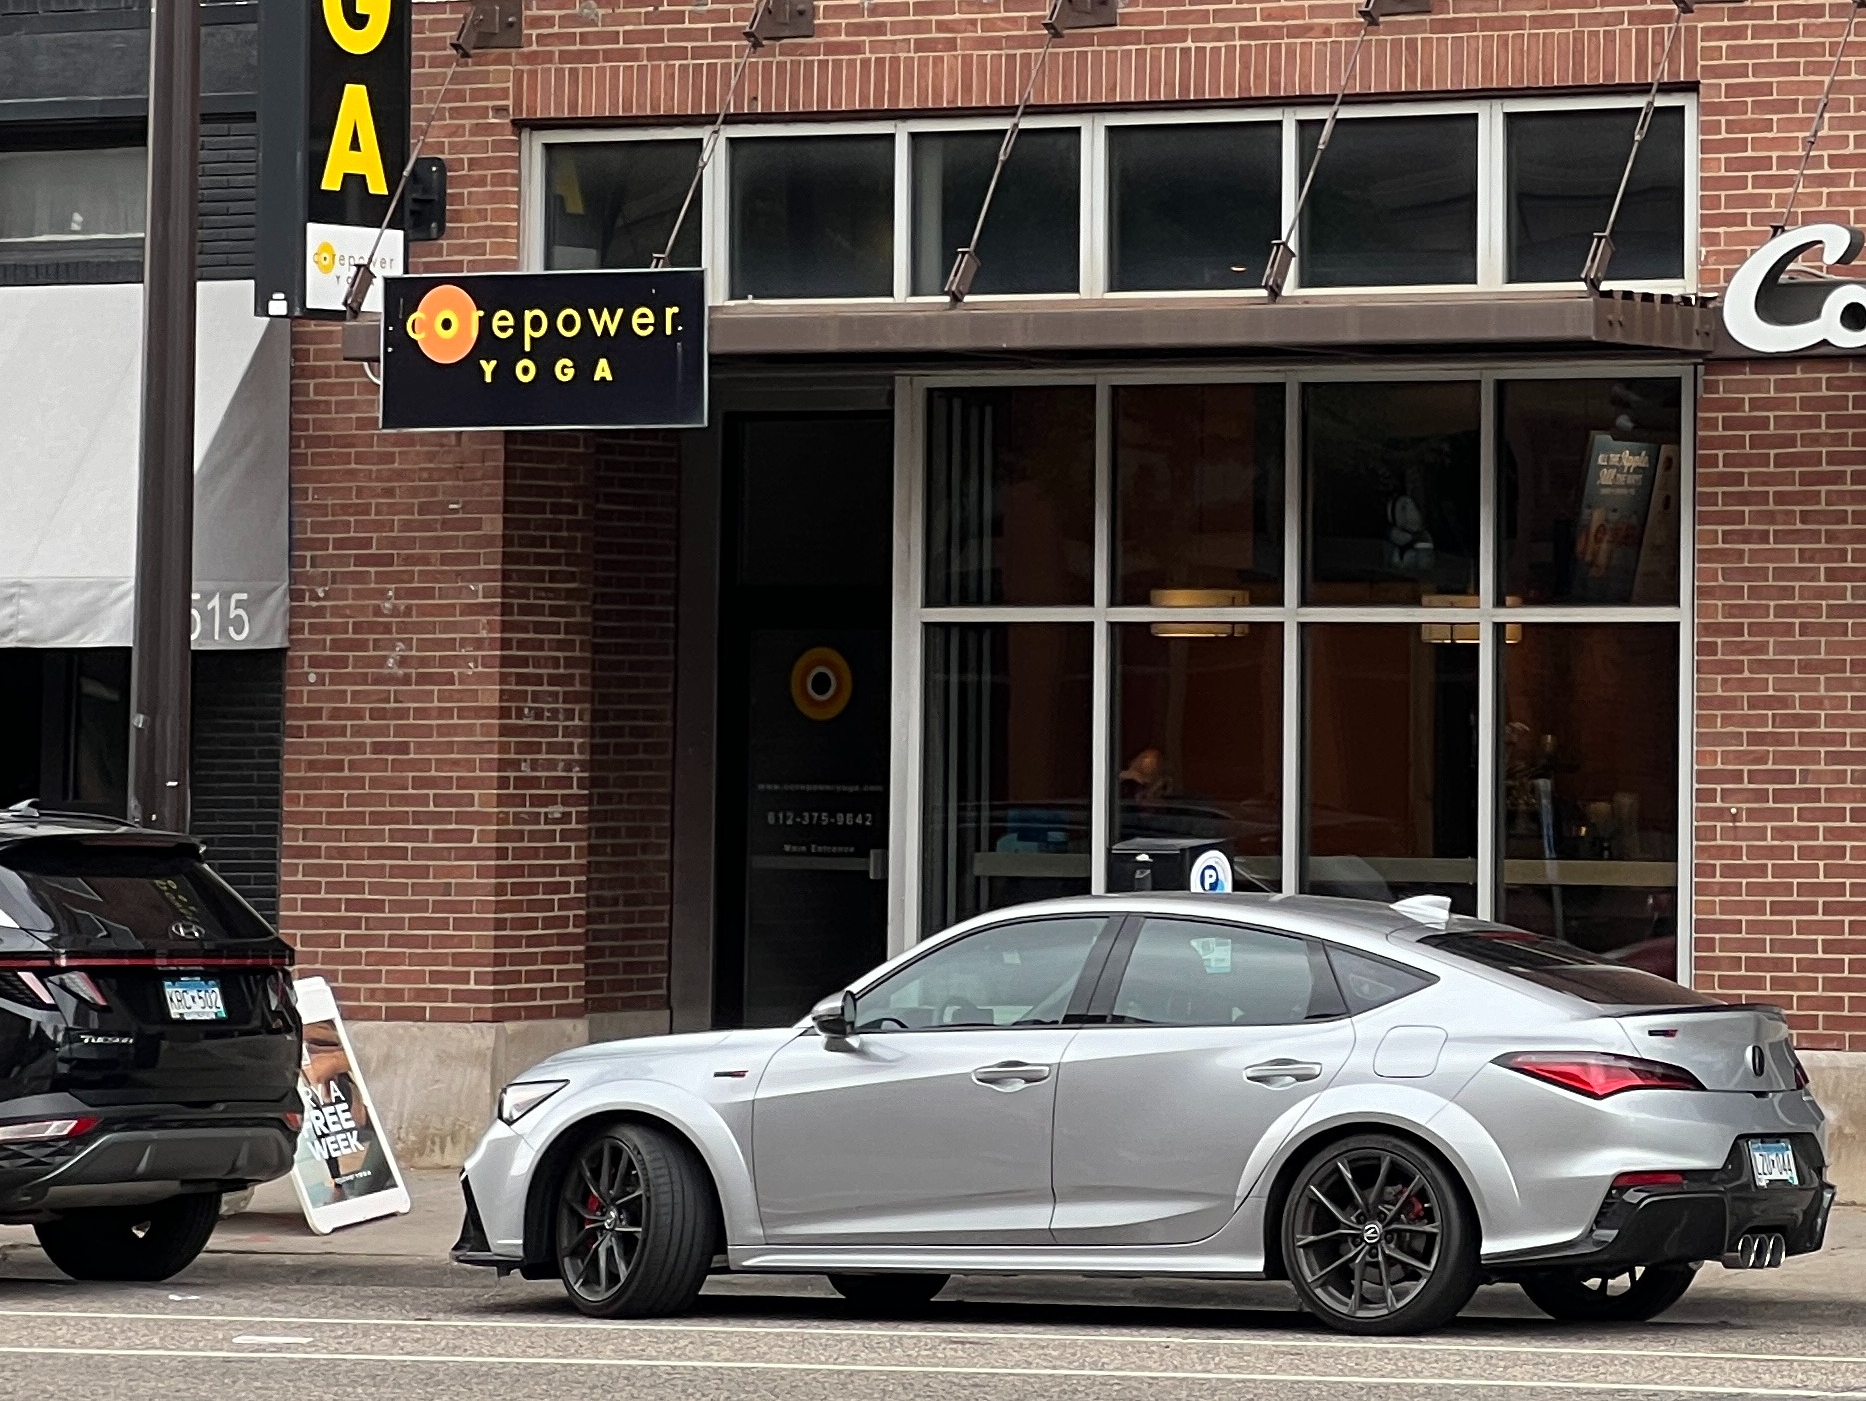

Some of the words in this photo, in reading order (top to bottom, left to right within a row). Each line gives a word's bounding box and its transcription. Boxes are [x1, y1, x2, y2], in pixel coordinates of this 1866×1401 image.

[406, 306, 680, 352] corepower
[479, 358, 613, 384] YOGA
[1204, 869, 1217, 891] P
[300, 1083, 324, 1108] RY
[329, 1080, 346, 1103] A
[307, 1130, 365, 1161] WEEK
